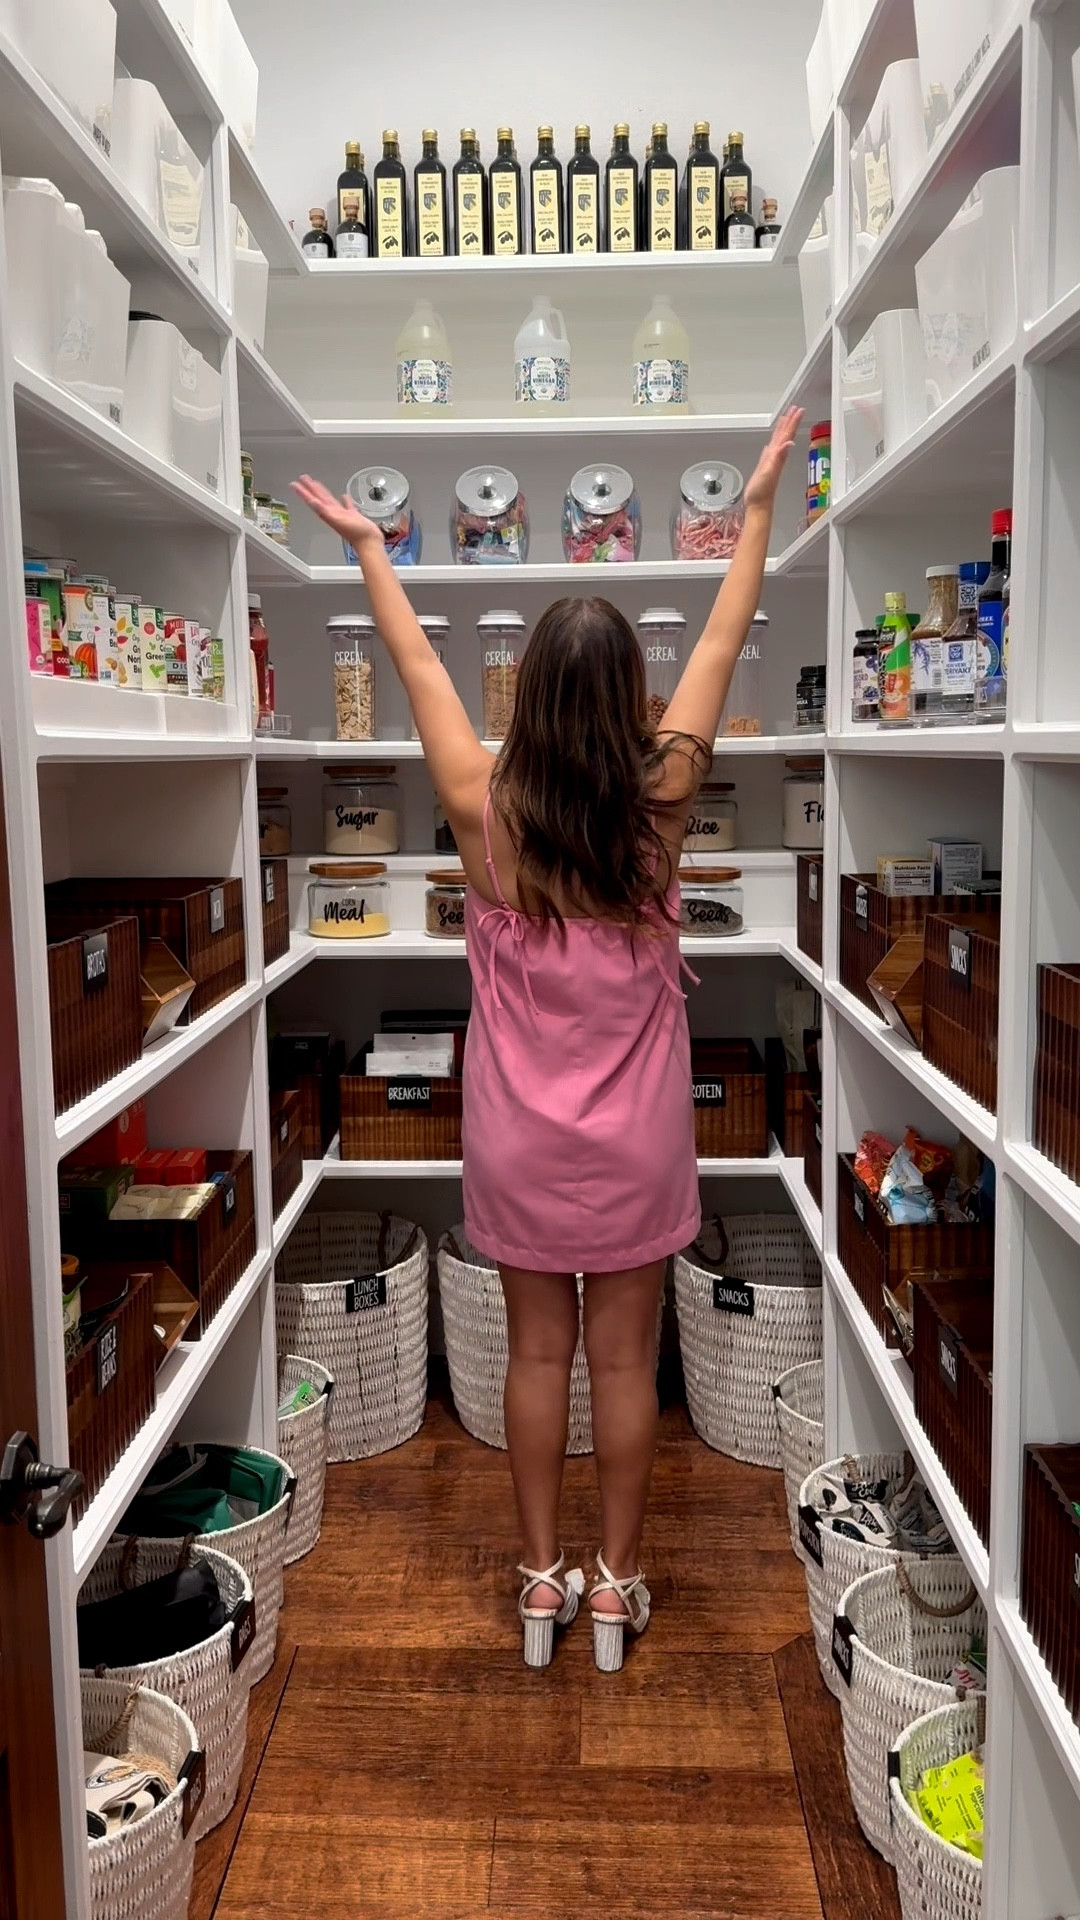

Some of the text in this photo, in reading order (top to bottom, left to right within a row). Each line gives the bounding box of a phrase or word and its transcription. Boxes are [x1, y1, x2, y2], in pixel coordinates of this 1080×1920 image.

[335, 651, 364, 666] CEREAL
[485, 651, 517, 666] CEREAL
[646, 646, 678, 661] CEREAL
[737, 645, 762, 660] REAL
[335, 805, 379, 831] Sugar
[324, 899, 366, 924] Meal
[687, 901, 730, 924] Seeds
[388, 1087, 431, 1101] BREAKFAST
[354, 1277, 379, 1297] LUNCH
[718, 1287, 749, 1307] SNACKS
[354, 1291, 380, 1311] BOXES
